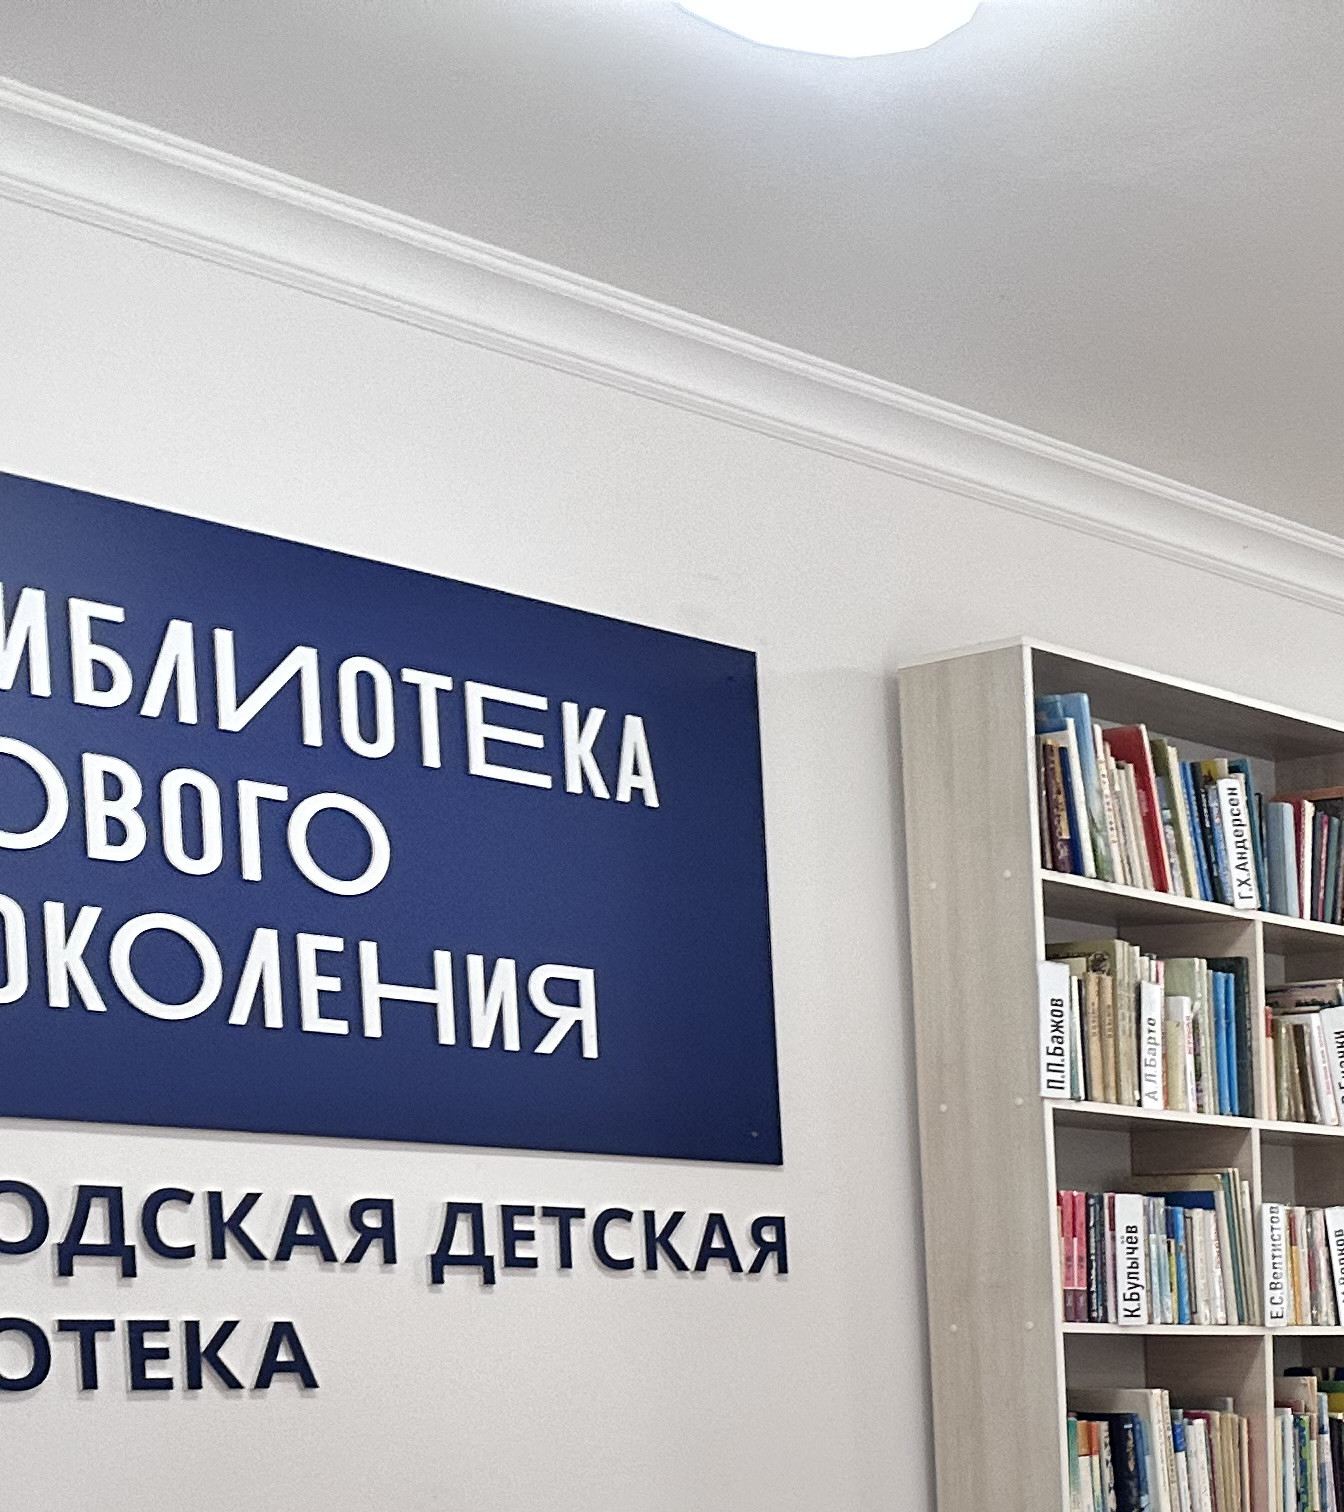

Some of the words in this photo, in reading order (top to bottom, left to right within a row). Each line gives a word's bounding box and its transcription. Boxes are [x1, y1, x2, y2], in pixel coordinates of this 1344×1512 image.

[1226, 786, 1257, 901] Г.Х.Андерсен
[1046, 997, 1065, 1090] П.П.Бажов
[431, 1201, 789, 1286] ДЕТСКАЯ
[1120, 1223, 1144, 1319] К.Булычёв
